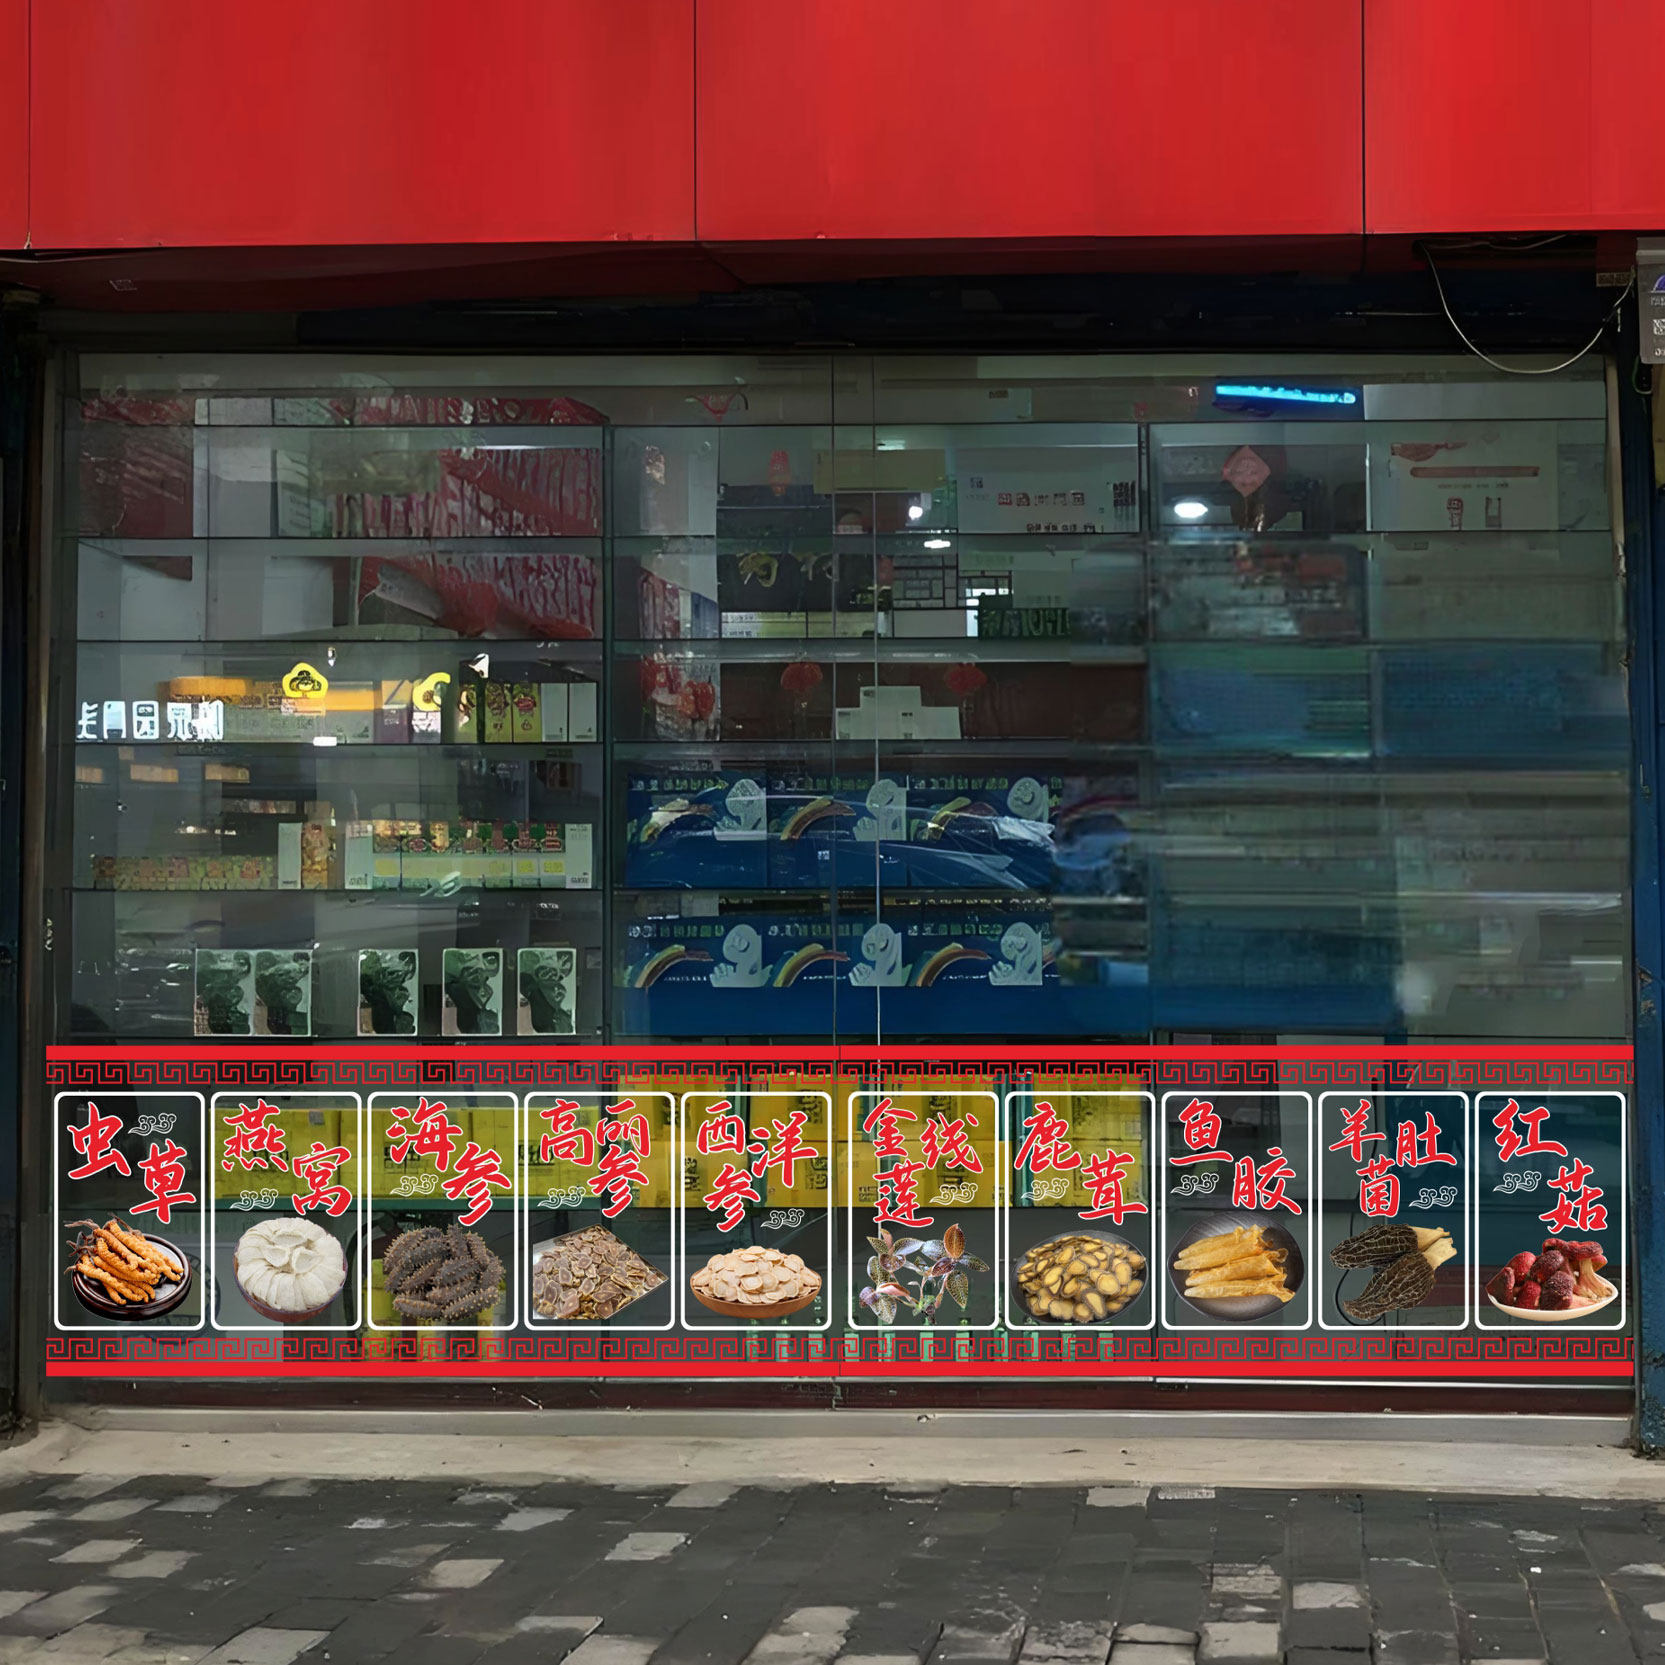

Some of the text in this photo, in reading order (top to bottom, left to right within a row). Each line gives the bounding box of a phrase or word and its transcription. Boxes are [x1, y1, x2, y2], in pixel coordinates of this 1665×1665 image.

[67, 1102, 196, 1224] 虫草
[222, 1099, 352, 1217] 燕窝
[386, 1097, 512, 1226] 海参
[1014, 1101, 1148, 1225] 鹿茸
[1169, 1098, 1302, 1215] 鱼胶
[1493, 1099, 1608, 1234] 红菇
